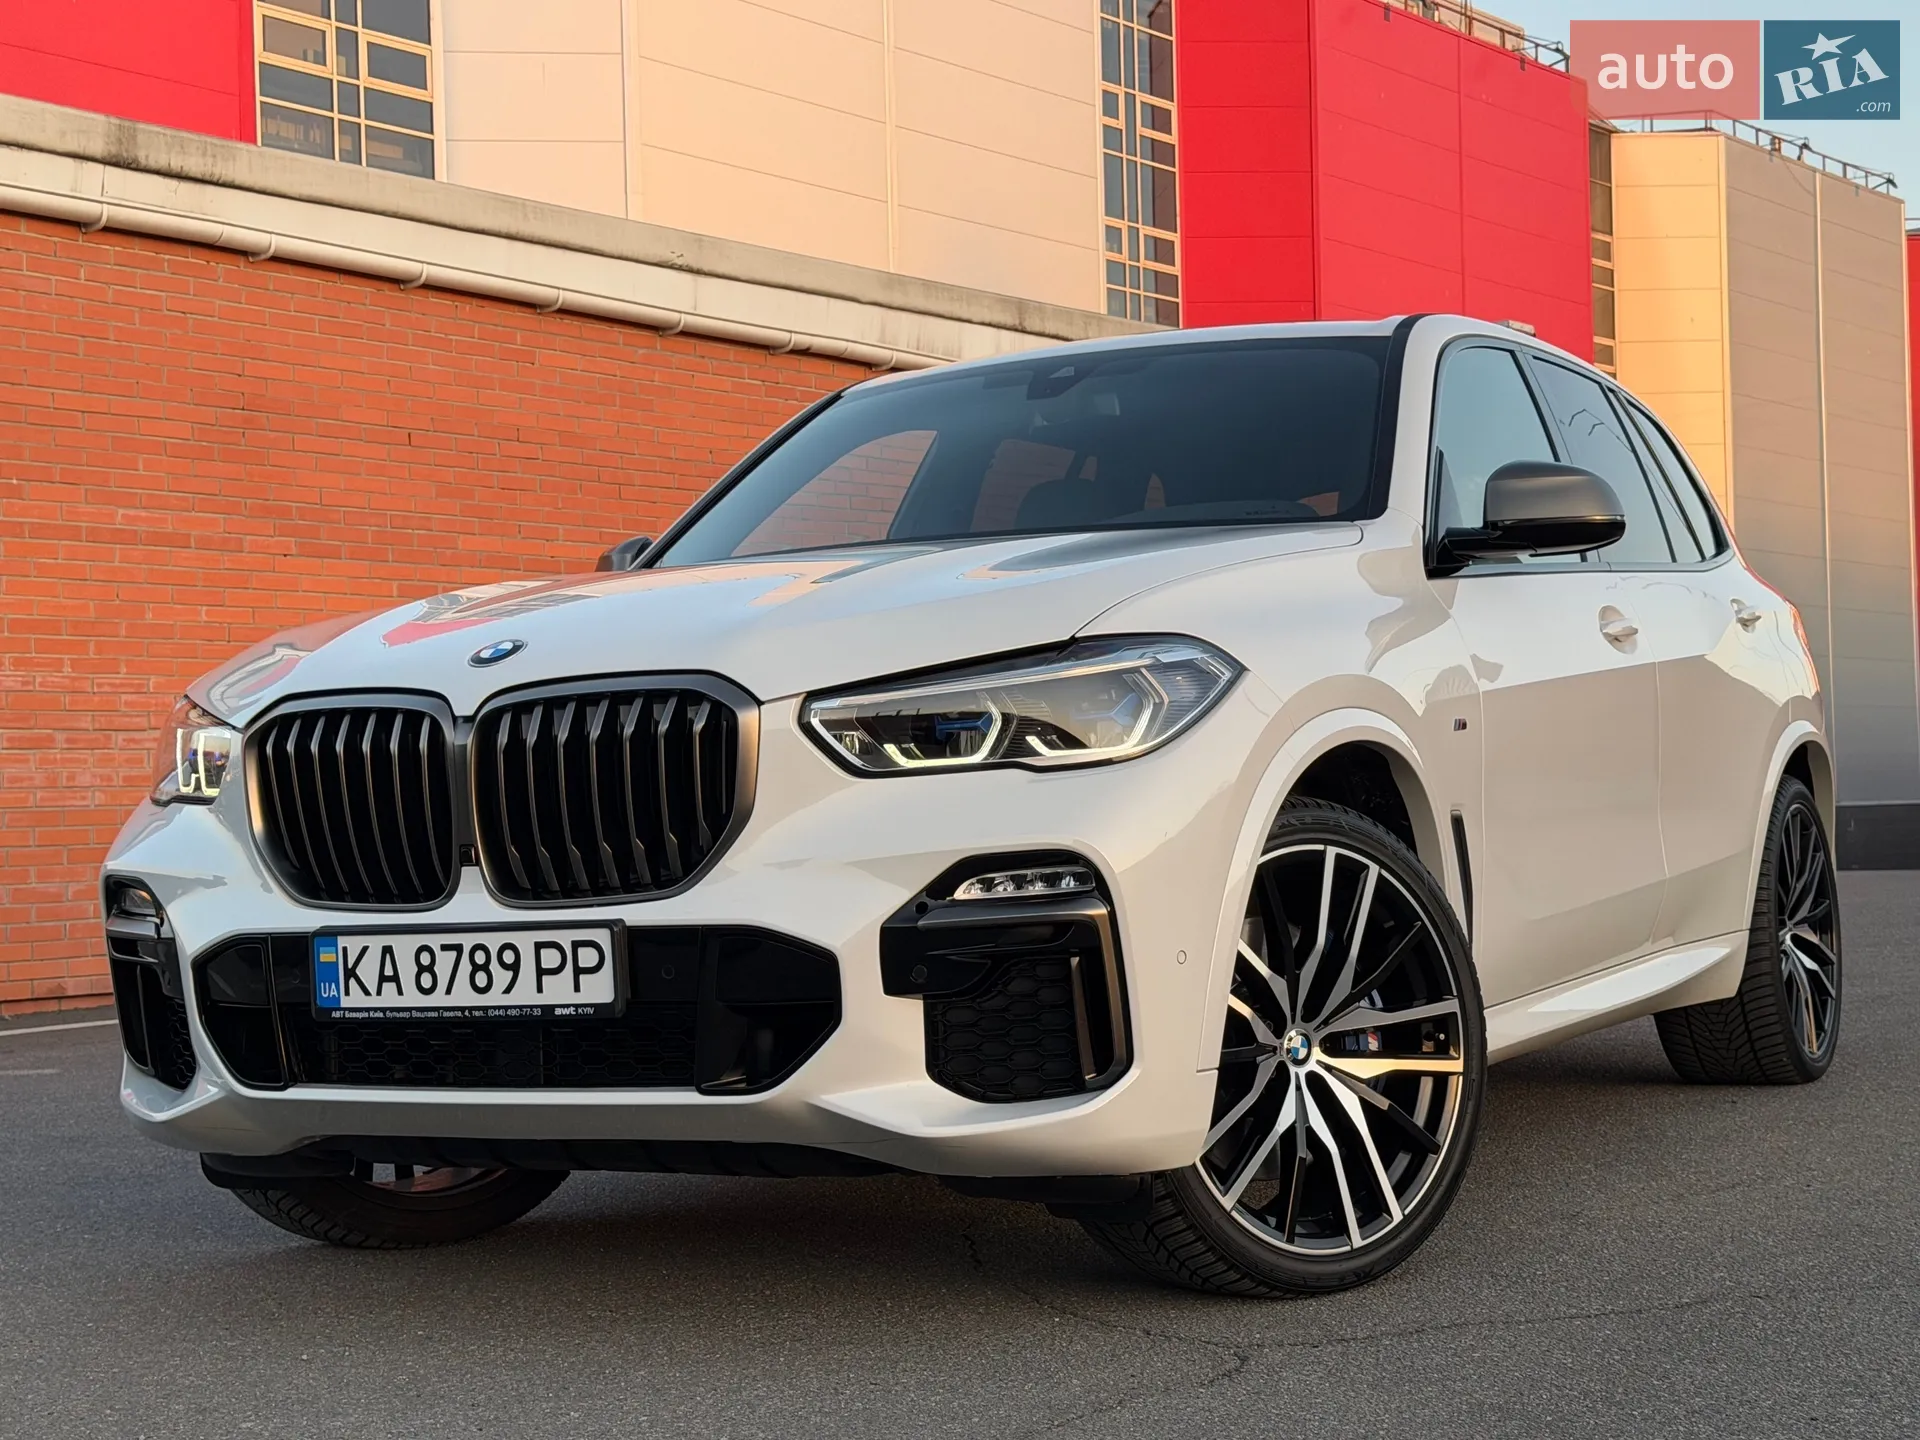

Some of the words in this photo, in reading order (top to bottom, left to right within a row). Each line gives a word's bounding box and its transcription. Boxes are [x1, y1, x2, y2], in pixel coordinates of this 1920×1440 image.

[341, 944, 404, 997] KA
[414, 942, 522, 996] 8789
[533, 939, 606, 994] PP
[320, 982, 338, 999] UA
[487, 1008, 506, 1017] (044)
[507, 1007, 542, 1016] 490-77-33
[554, 1005, 576, 1015] awt
[578, 1007, 595, 1015] KYIV
